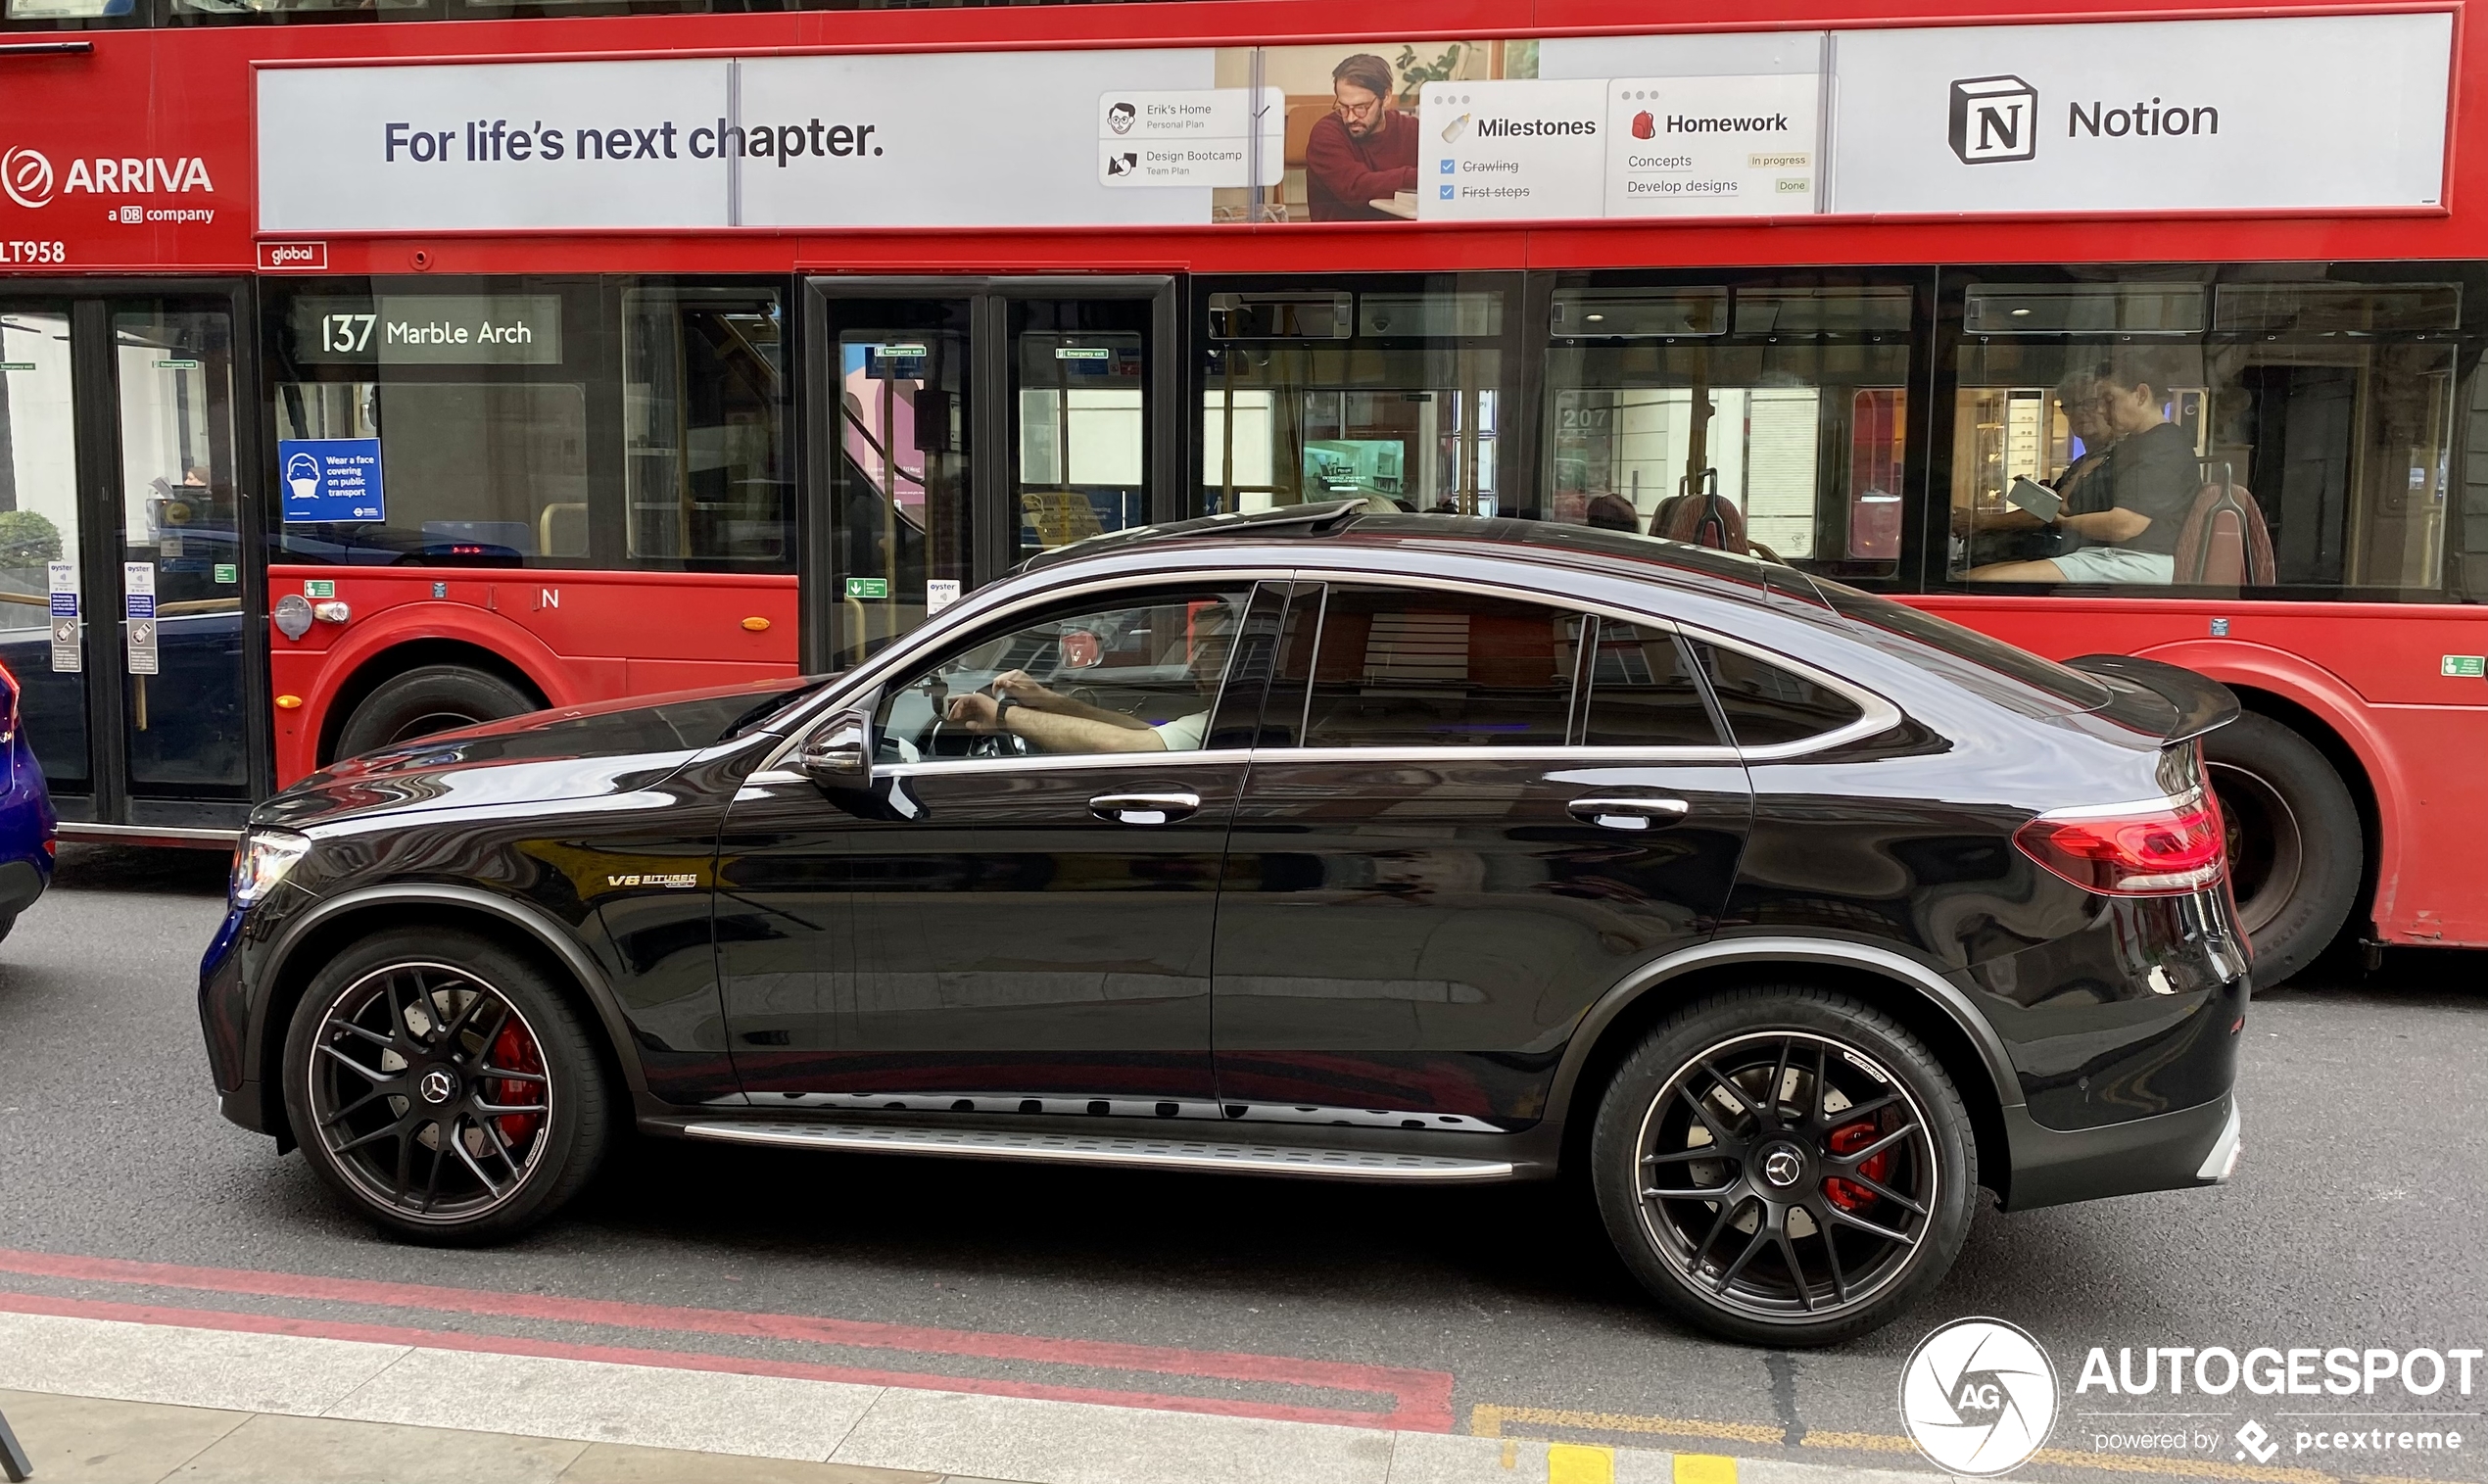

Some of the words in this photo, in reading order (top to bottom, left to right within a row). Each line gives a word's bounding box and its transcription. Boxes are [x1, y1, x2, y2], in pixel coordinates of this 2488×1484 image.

[1147, 104, 1176, 115] Erik's
[1179, 104, 1212, 115] Home
[1666, 113, 1789, 133] Homework
[2069, 96, 2218, 137] Notion
[1146, 120, 1183, 129] Personal
[1478, 118, 1597, 137] Milestones
[1975, 104, 2024, 151] N
[386, 121, 455, 163] For
[576, 121, 678, 160] next
[689, 118, 884, 168] chapter.
[1146, 151, 1184, 163] Design
[1187, 151, 1242, 162] Bootcamp
[1628, 155, 1693, 168] Concepts
[1751, 156, 1761, 166] In
[1763, 156, 1806, 167] progress
[1146, 167, 1169, 175] Team
[1171, 167, 1190, 175] Plan
[1462, 160, 1519, 174] Crawling
[64, 157, 215, 194] ARRIVA
[1627, 180, 1682, 195] Develop
[1686, 179, 1739, 193] designs
[1780, 181, 1805, 190] Done
[1461, 186, 1490, 198] First
[1495, 186, 1530, 199] steps
[108, 210, 118, 221] a
[122, 207, 141, 222] DB
[147, 209, 215, 223] company
[0, 241, 66, 263] LT958
[271, 245, 312, 265] global
[322, 313, 377, 353] 137
[386, 321, 468, 344] Marble
[477, 320, 532, 344] Arch
[1563, 408, 1607, 428] 207
[325, 455, 348, 465] Wear
[326, 467, 362, 476] covering
[340, 477, 366, 488] public
[328, 489, 366, 499] transport
[930, 583, 956, 592] oyster
[542, 588, 559, 609] N
[607, 875, 641, 886] V8
[643, 874, 697, 883] BITURBO
